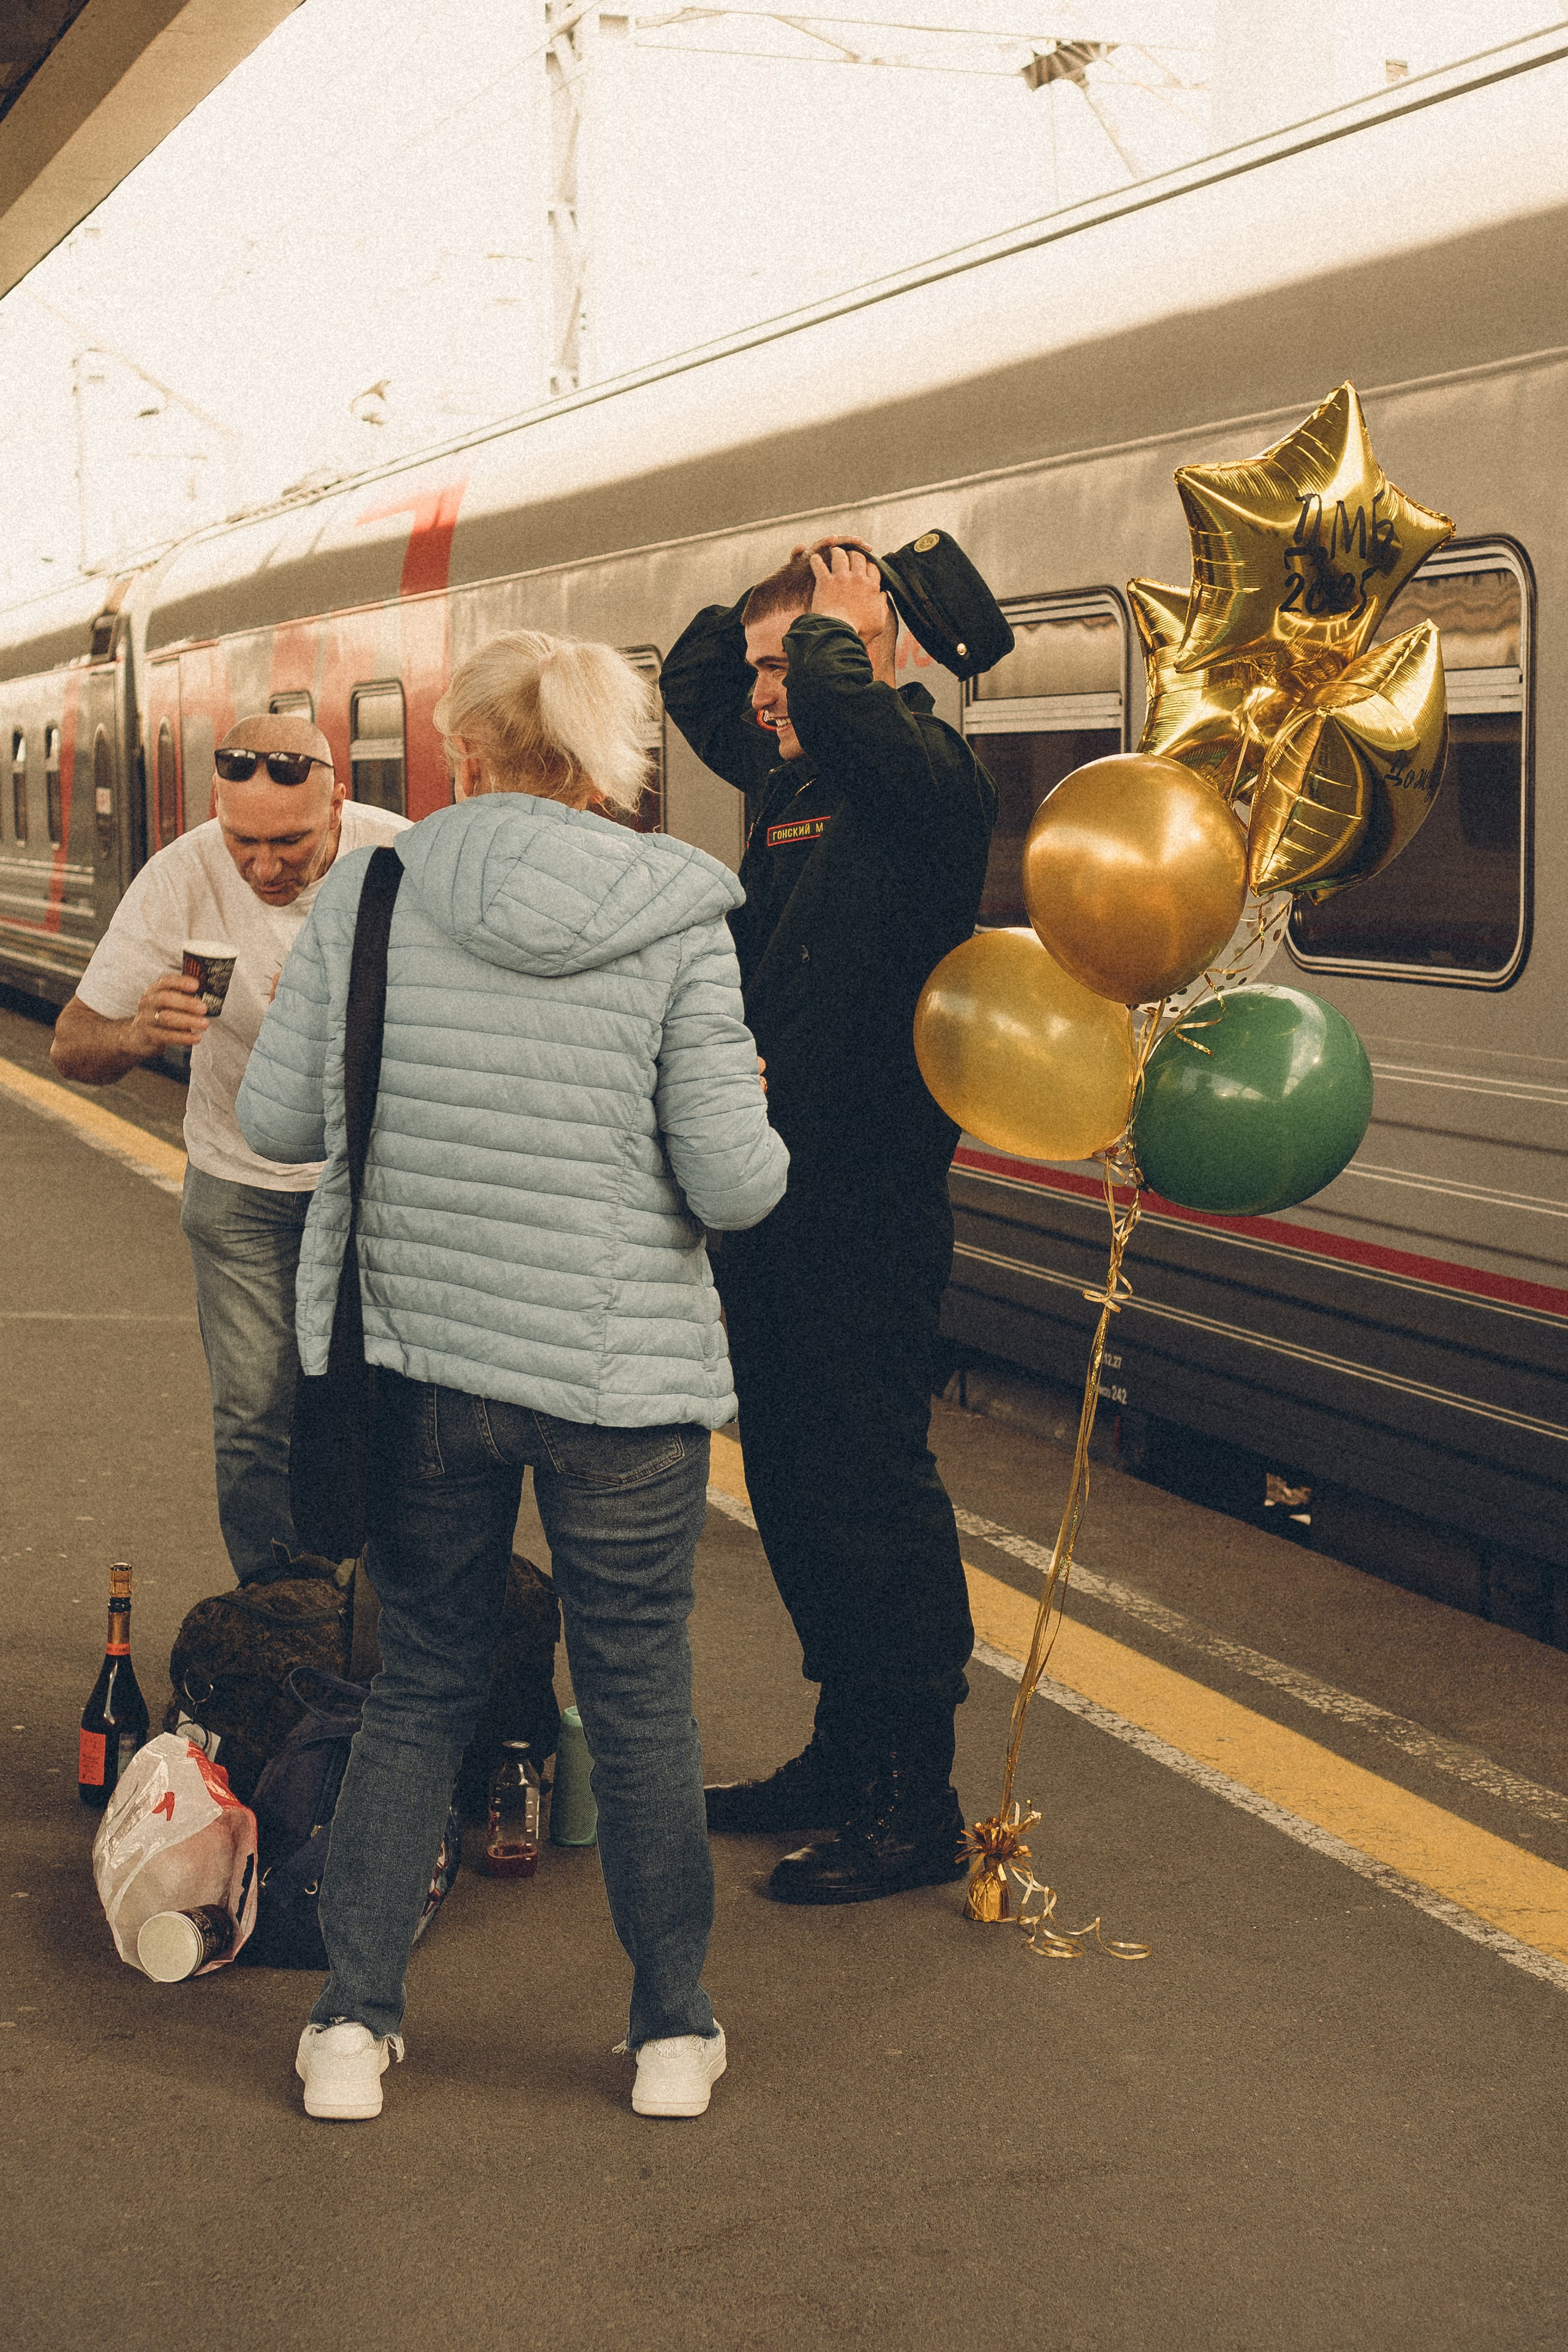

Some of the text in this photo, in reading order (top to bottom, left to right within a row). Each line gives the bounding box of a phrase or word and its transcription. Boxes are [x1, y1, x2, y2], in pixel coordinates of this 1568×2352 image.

[1284, 490, 1394, 570] ДМБ
[1278, 565, 1379, 621] 2025
[772, 823, 810, 841] ГОНСКИЙ
[1112, 1385, 1127, 1405] 242
